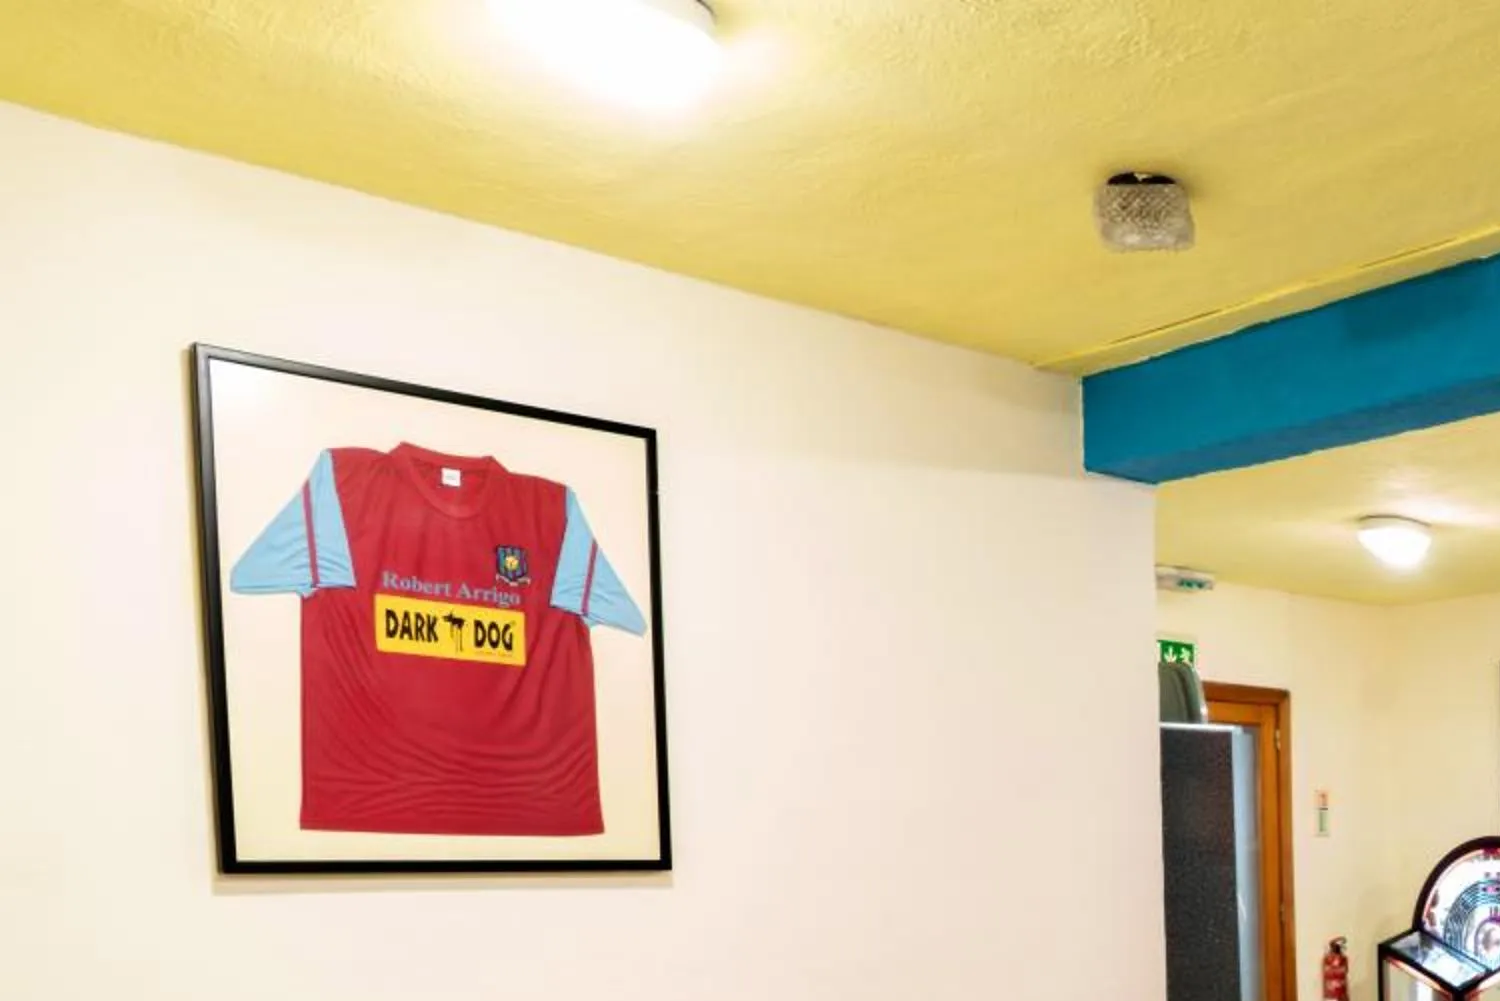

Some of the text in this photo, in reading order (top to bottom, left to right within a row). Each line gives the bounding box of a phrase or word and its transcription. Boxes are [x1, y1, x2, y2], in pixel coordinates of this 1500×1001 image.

[382, 570, 521, 608] Robert Arrigo
[385, 608, 513, 651] DARK DOG
